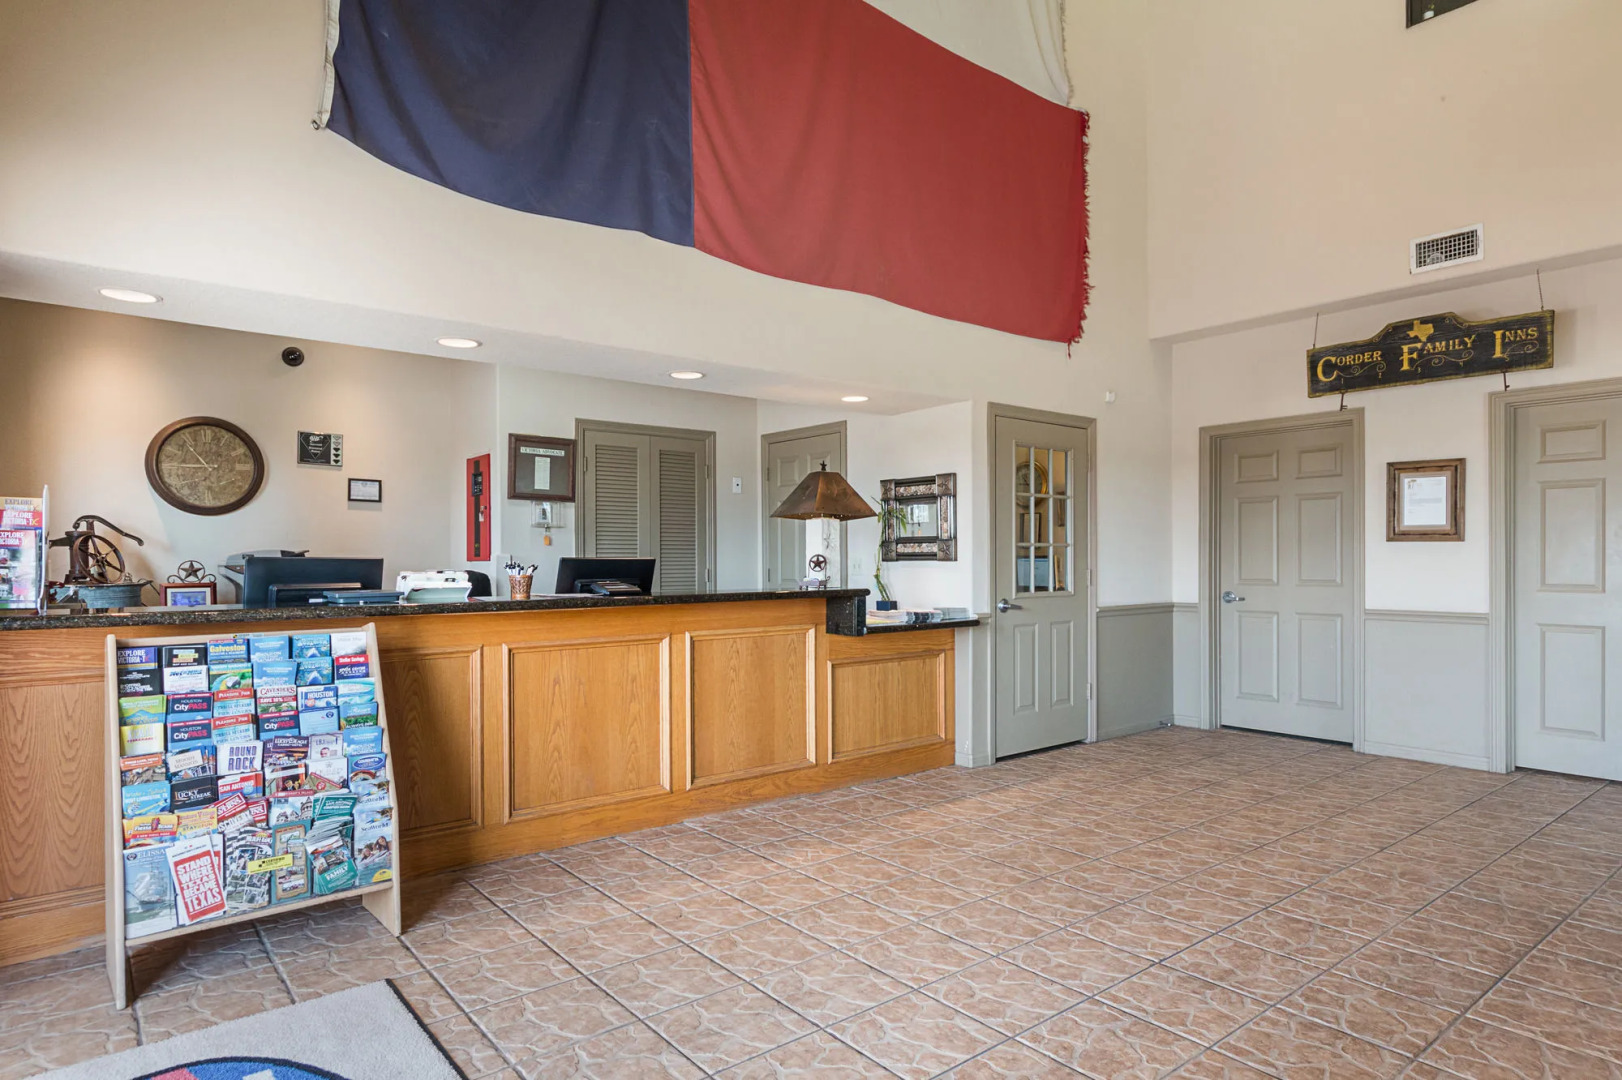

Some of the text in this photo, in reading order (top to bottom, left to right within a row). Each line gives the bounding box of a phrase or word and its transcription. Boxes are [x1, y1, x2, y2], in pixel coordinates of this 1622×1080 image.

[1317, 327, 1538, 382] CORDER FAMILY INNS
[118, 649, 146, 657] EXPLORE
[210, 645, 246, 653] Galveston
[260, 687, 296, 696] CAVENDER'S
[174, 703, 208, 711] CityPASS
[264, 720, 295, 730] CityPASS
[173, 730, 208, 740] CityPASS
[229, 746, 257, 757] ROUND
[228, 757, 256, 771] ROCK
[231, 780, 255, 790] ANTONIO
[175, 790, 199, 801] LUCKY
[190, 792, 212, 800] STREAK
[361, 823, 389, 832] SeaWorld
[139, 849, 166, 857] ELISSA
[176, 856, 211, 873] STAND
[179, 864, 214, 884] WHERE
[325, 863, 348, 881] FAMILY
[181, 874, 216, 890] TEXAS
[183, 880, 219, 899] BECAME
[185, 888, 221, 913] TEXAS
